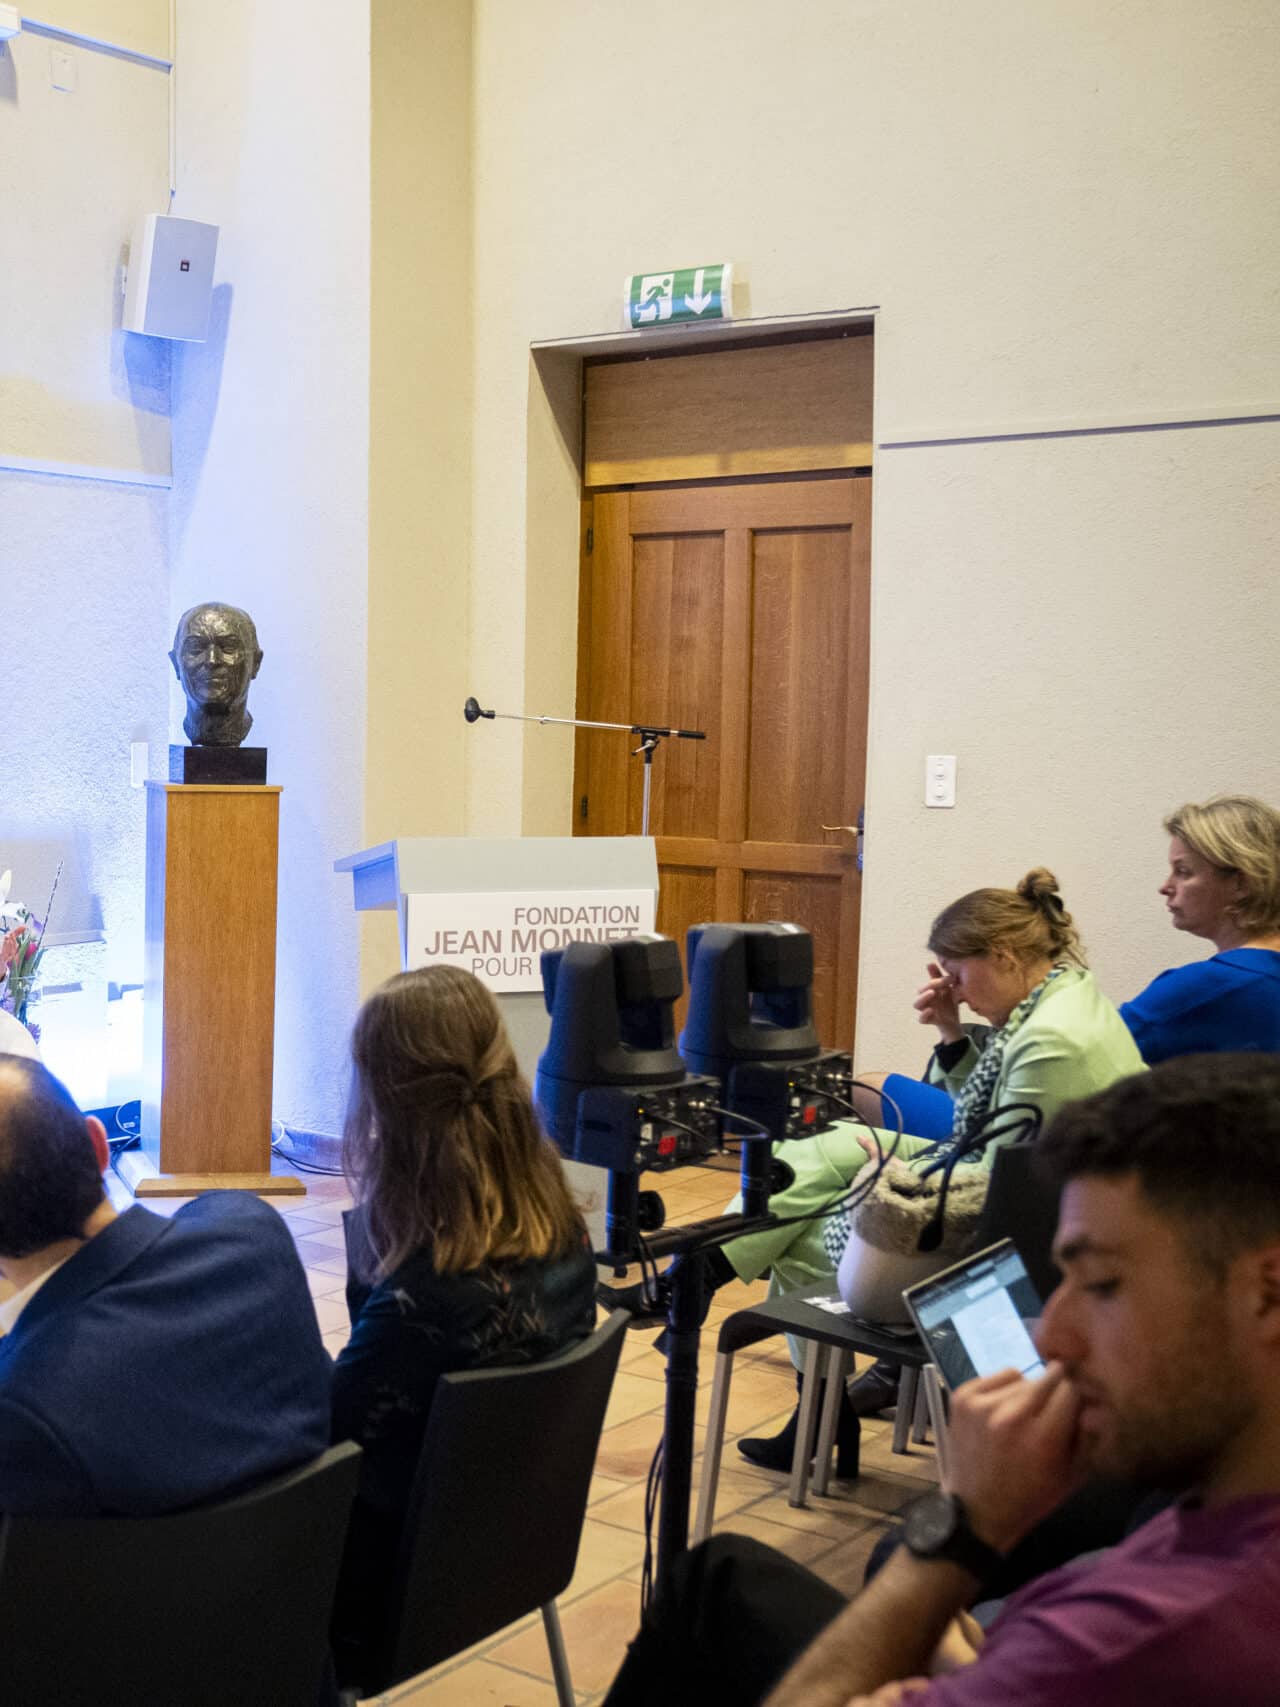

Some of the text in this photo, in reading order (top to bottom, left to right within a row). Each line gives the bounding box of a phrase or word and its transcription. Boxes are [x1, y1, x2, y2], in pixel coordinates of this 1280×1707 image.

[514, 905, 640, 926] FONDATION
[424, 930, 502, 955] JEAN
[472, 957, 532, 977] POUR
